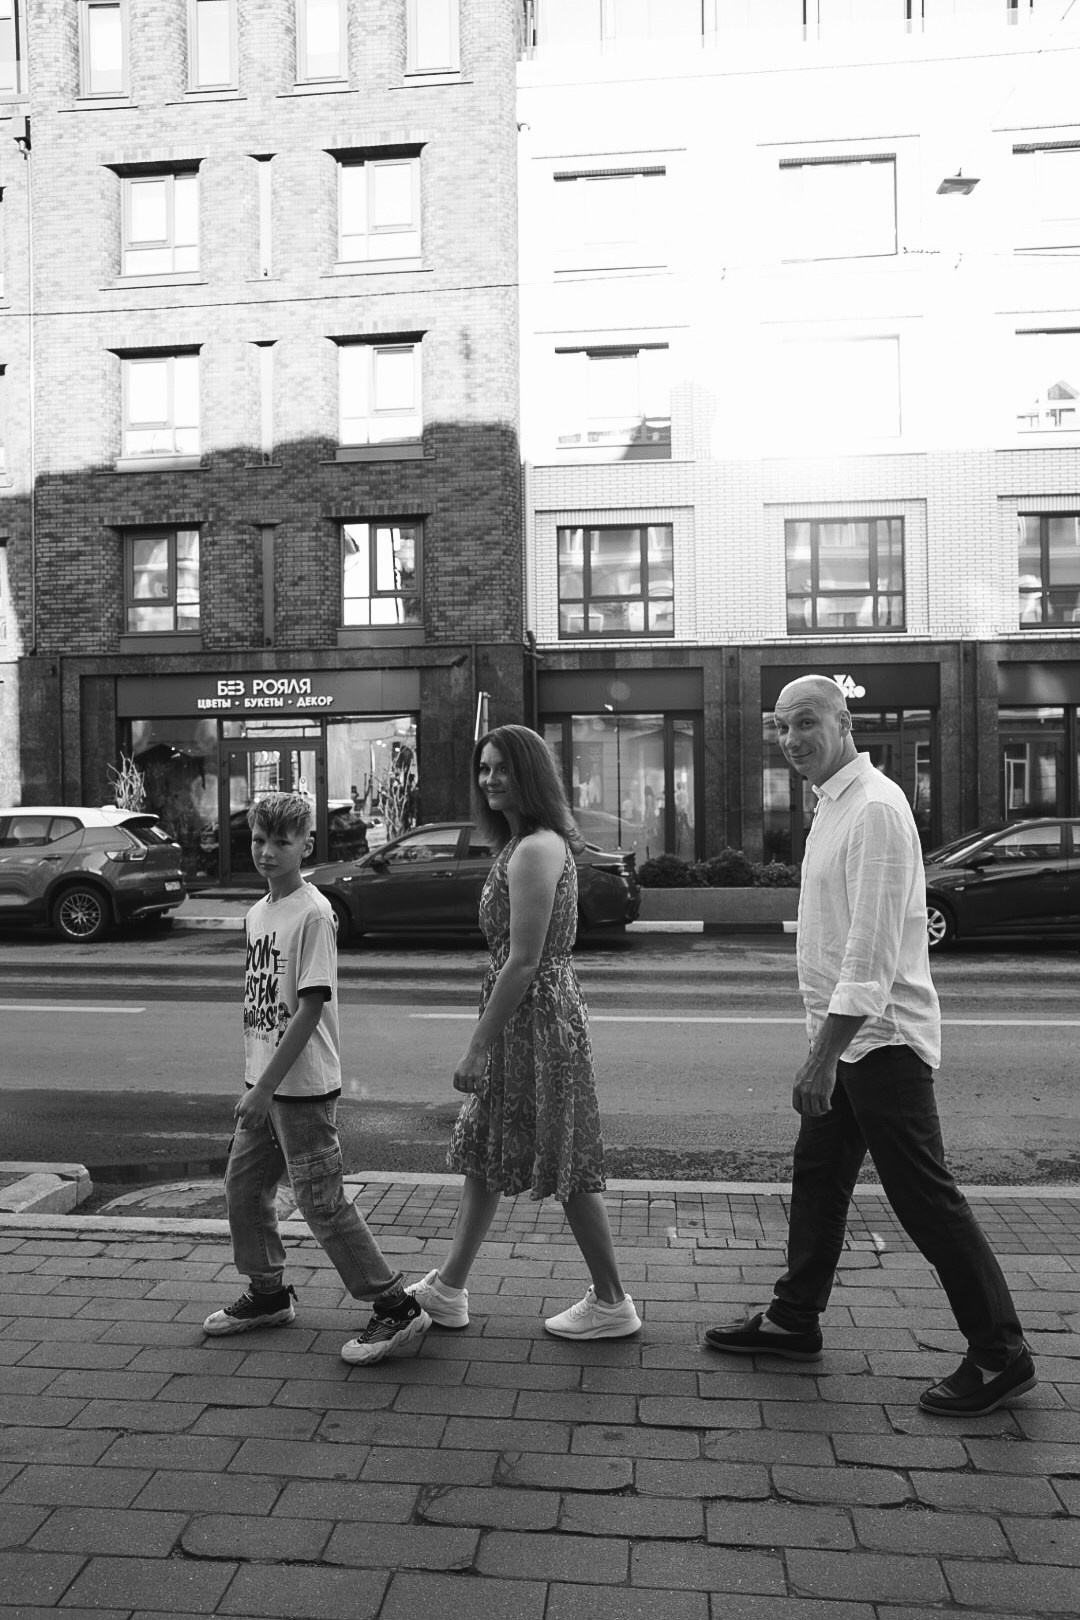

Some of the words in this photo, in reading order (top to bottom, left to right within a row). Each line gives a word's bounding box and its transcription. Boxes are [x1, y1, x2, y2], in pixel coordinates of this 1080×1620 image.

[217, 680, 245, 696] БЕЗ
[252, 678, 311, 695] РОЯЛЯ
[197, 699, 231, 709] ЦВЕТЫ
[244, 697, 284, 708] БУКЕТЫ
[296, 696, 334, 708] ДЕКОР
